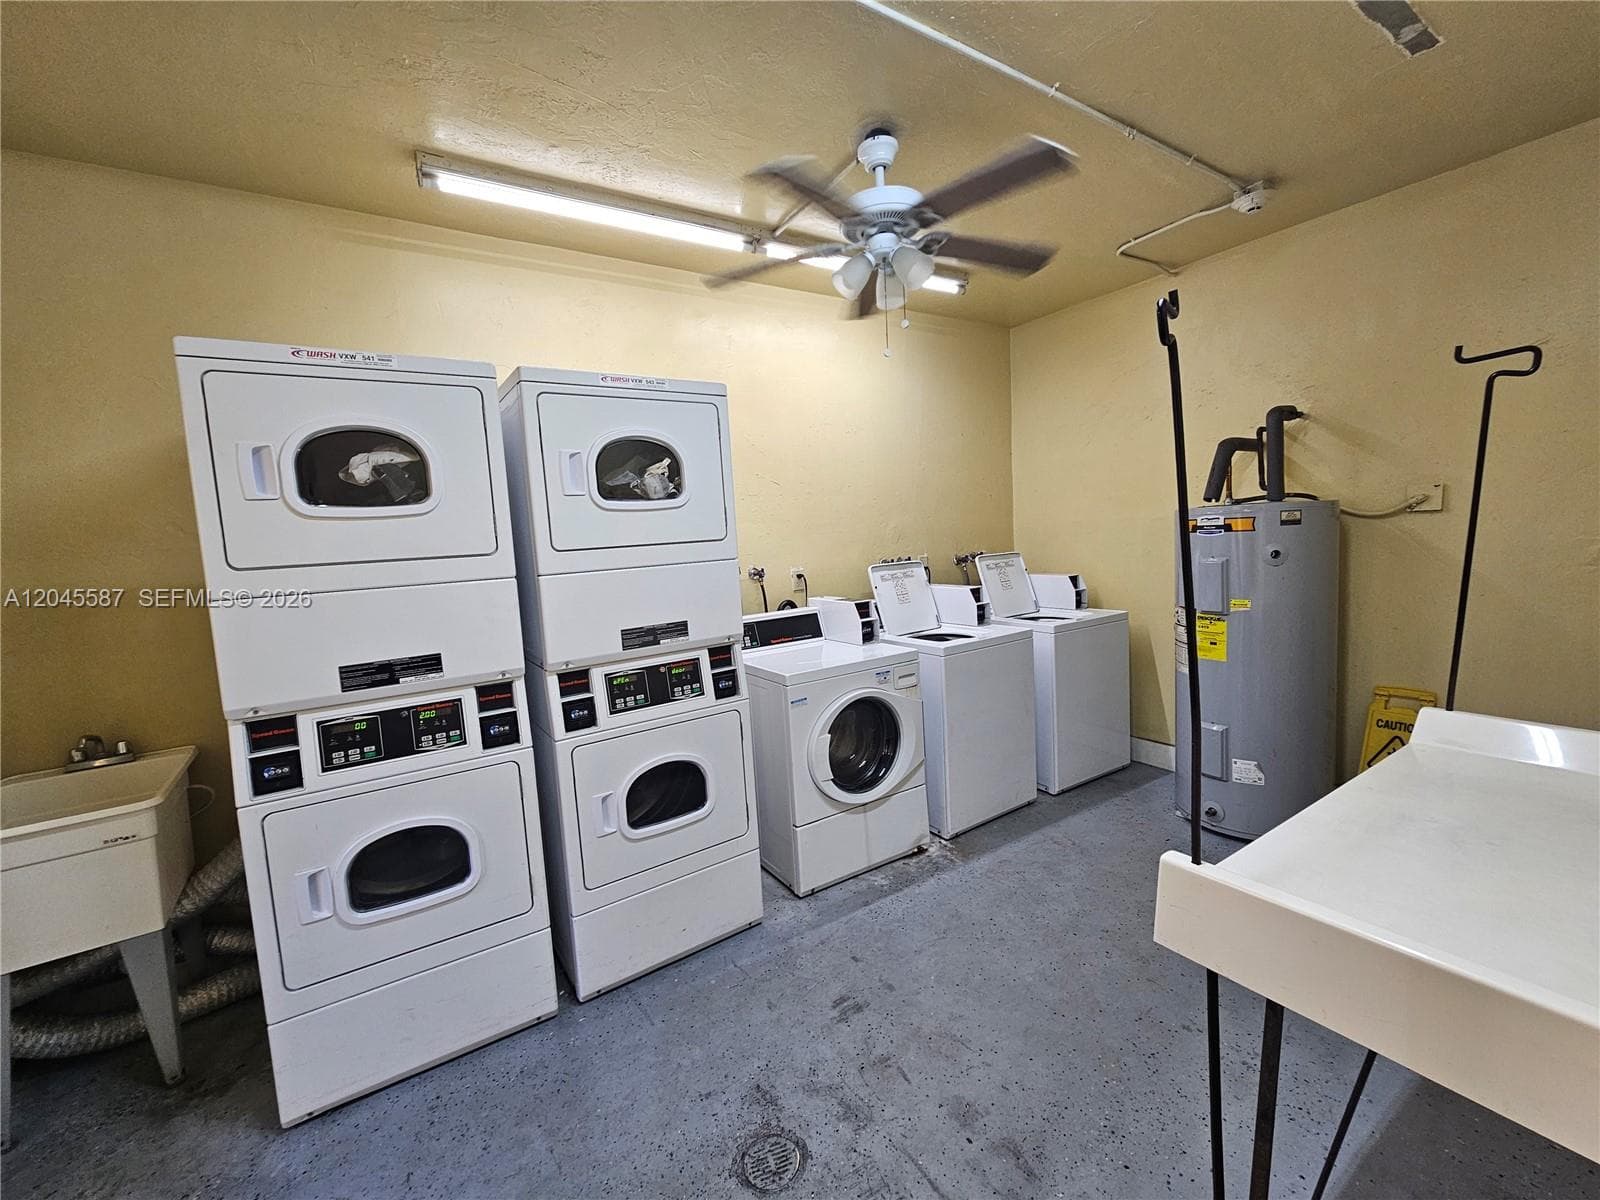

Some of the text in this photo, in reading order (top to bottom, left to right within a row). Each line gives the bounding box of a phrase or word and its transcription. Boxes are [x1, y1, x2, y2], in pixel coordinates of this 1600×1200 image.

[306, 351, 336, 359] WASH
[339, 353, 357, 361] VXW
[1376, 718, 1415, 733] CAUTIO
